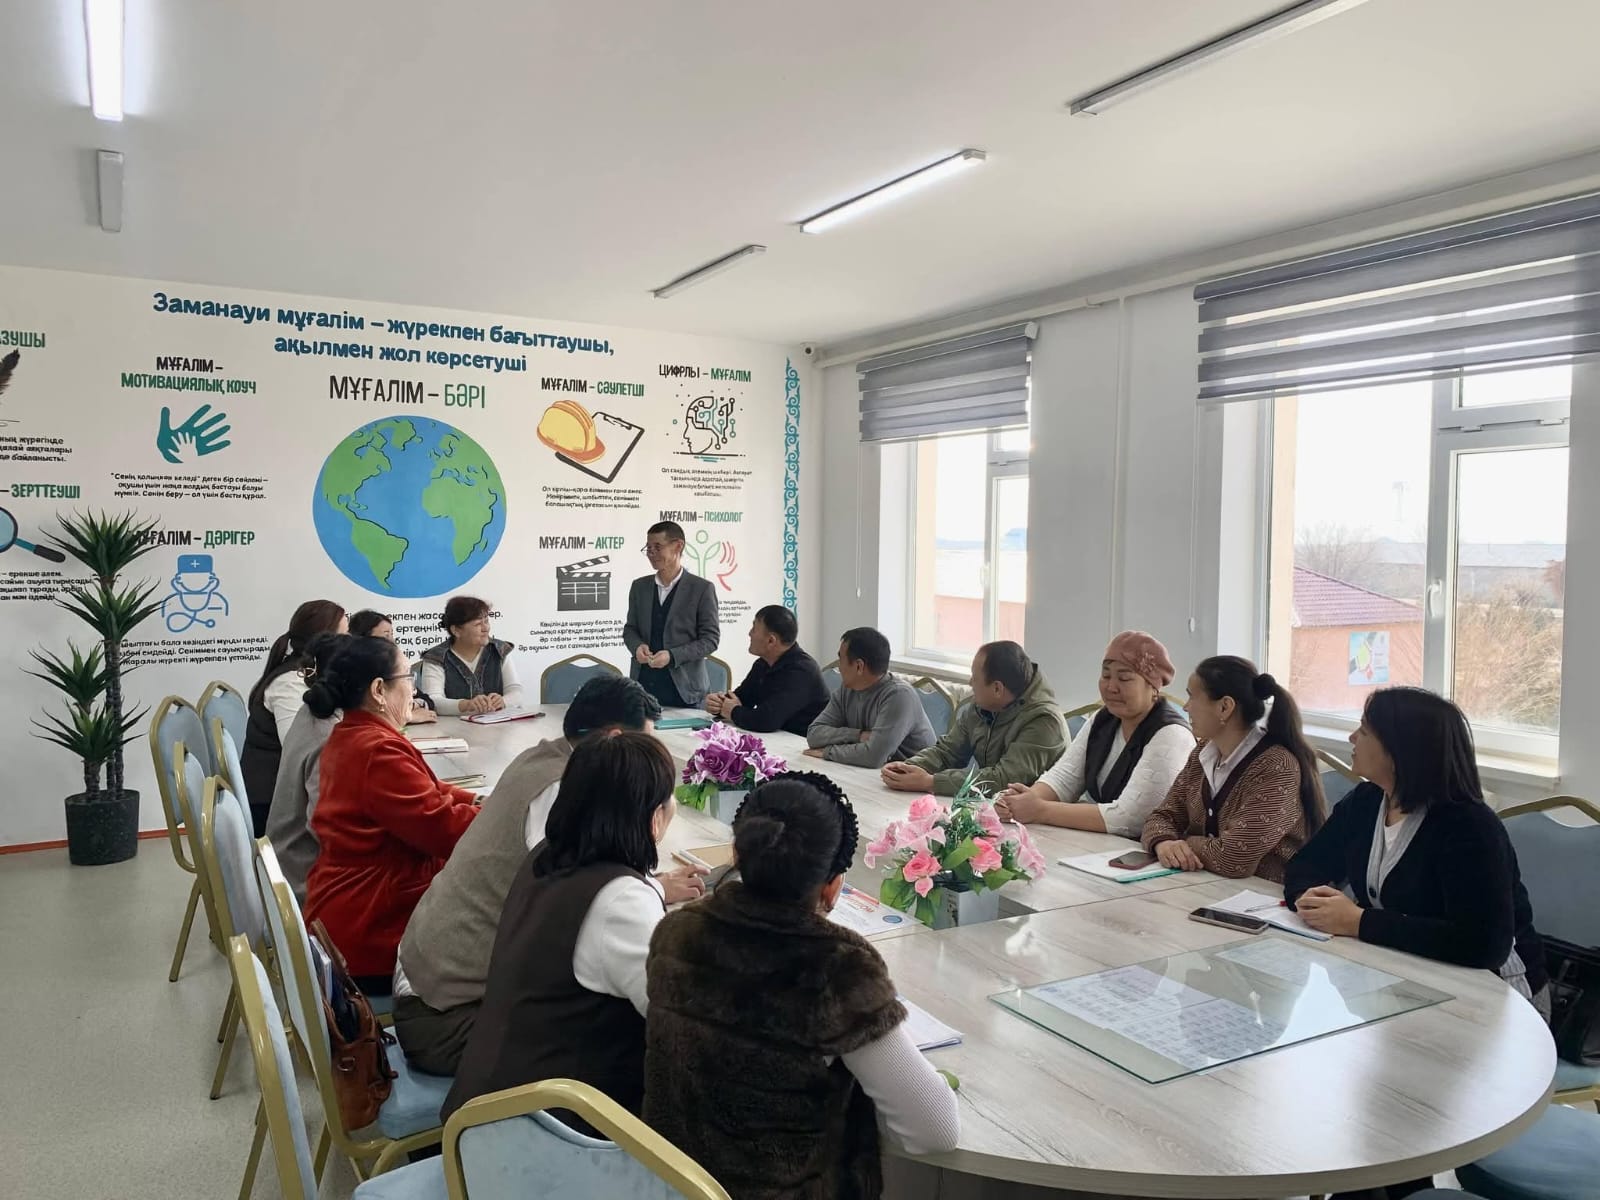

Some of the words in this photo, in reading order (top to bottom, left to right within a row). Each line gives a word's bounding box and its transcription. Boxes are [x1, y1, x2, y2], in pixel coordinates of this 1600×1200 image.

[153, 292, 270, 324] Заманауи
[277, 307, 364, 331] мұғалім
[387, 319, 485, 342] жүрекпен
[490, 325, 614, 355] бағыттаушы,
[0, 330, 45, 348] ЗУШЫ
[156, 356, 213, 373] МҰҒАЛІМ
[274, 337, 373, 359] ақылмен
[379, 346, 420, 362] жол
[426, 350, 527, 373] көрсетуші
[121, 372, 225, 394] МОТИВАЦИЯЛЫҚ
[226, 379, 257, 394] КОУЧ
[659, 364, 700, 379] ЦИФРЛЫ
[710, 368, 752, 383] МҰҒАЛІМ
[329, 374, 424, 404] МҰҒАЛІМ
[444, 383, 486, 408] БӘРІ
[541, 377, 588, 393] МҰҒАЛІМ
[597, 380, 645, 397] СӘУЛЕТШІ
[11, 484, 80, 499] ЗЕРТТЕУШІ
[660, 510, 697, 521] МҰҒАЛІМ
[704, 511, 743, 522] ПСИХОЛОГ
[203, 530, 255, 549] ДӘРІГЕР
[539, 536, 586, 549] МҰҒАЛІМ
[595, 536, 625, 549] АКТЕР
[415, 635, 443, 646] беріп
